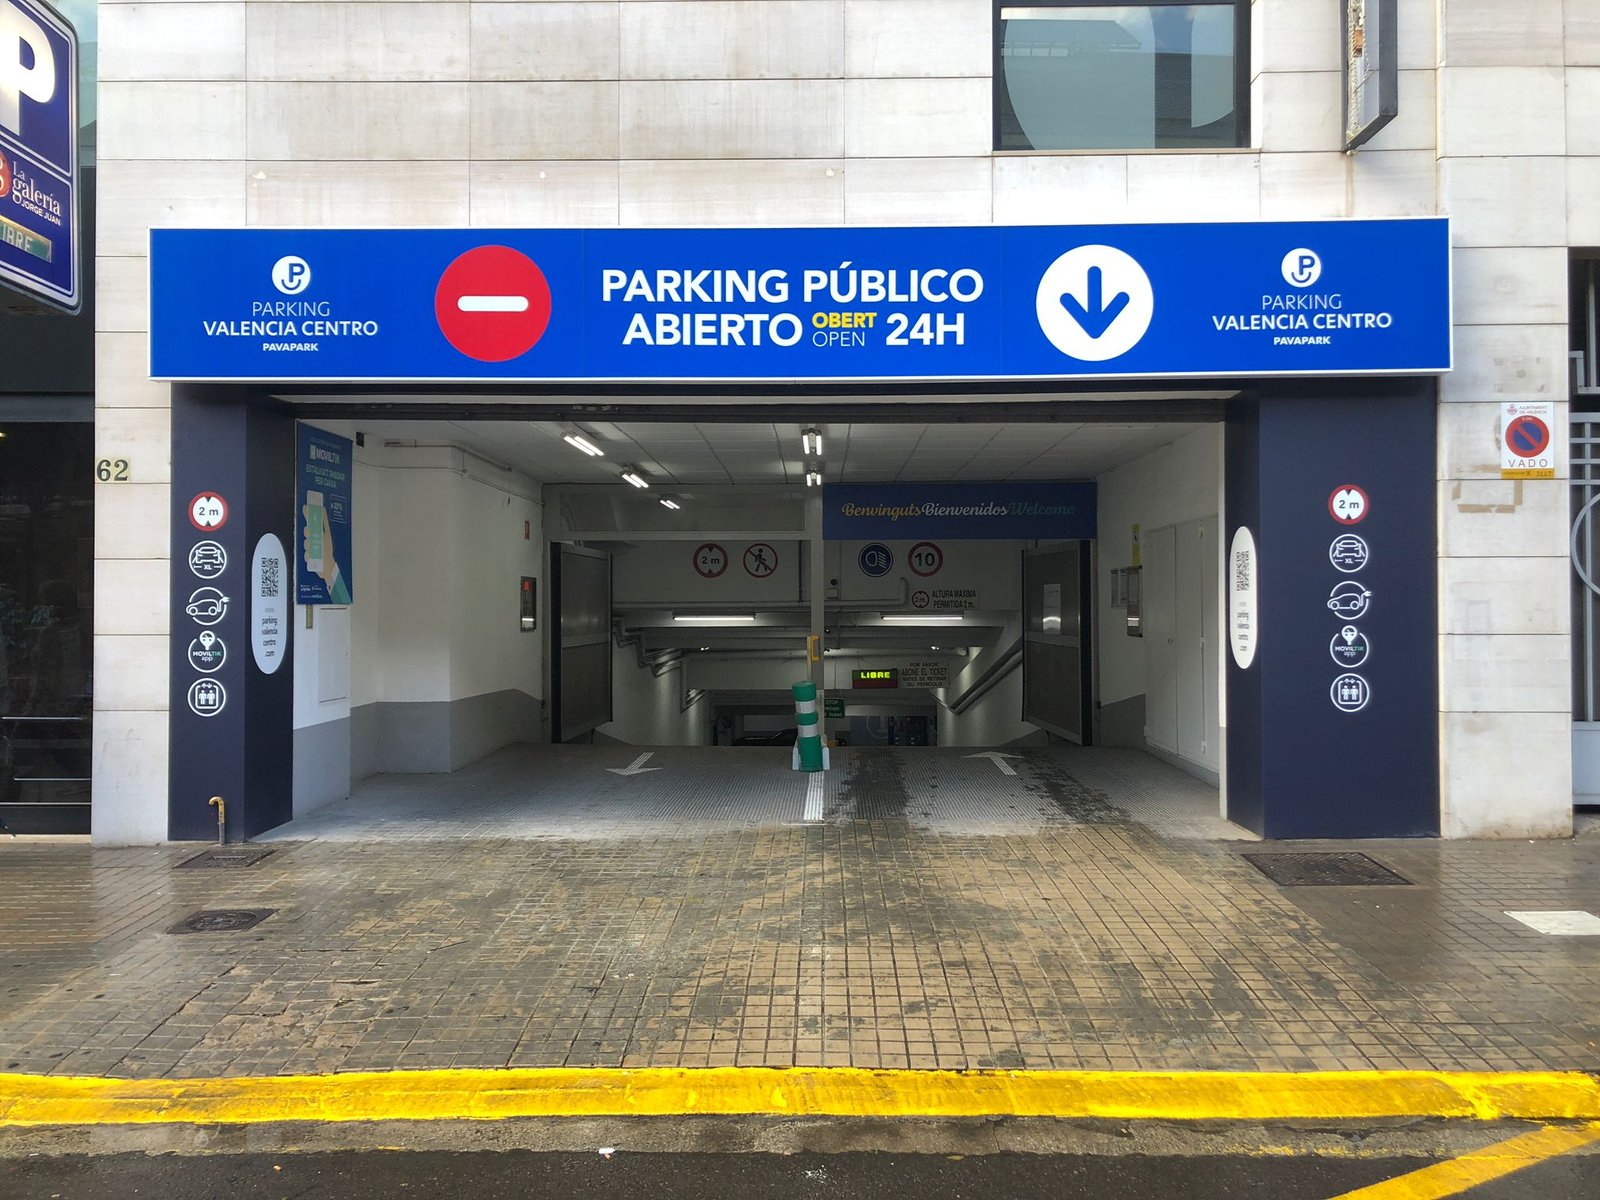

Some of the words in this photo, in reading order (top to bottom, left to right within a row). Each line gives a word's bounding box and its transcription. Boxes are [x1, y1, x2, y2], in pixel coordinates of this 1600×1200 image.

[13, 161, 25, 181] La
[12, 178, 61, 217] galería
[21, 199, 43, 217] JORGE
[43, 212, 61, 227] JUAN
[2, 223, 33, 252] IBRE
[602, 268, 789, 303] PARKING
[804, 261, 984, 303] PÚBLICO
[252, 301, 330, 317] PARKING
[1262, 293, 1342, 311] PARKING
[203, 320, 297, 337] VALENCIA
[301, 320, 378, 337] CENTRO
[622, 312, 803, 347] ABIERTO
[811, 311, 878, 329] OBERT
[885, 312, 965, 346] 24H
[1212, 313, 1309, 331] VALENCIA
[1312, 312, 1393, 330] CENTRO
[812, 330, 867, 347] OPEN
[1273, 335, 1331, 346] PAVAPARK
[262, 342, 319, 352] PAVAPARK
[96, 459, 129, 482] 62
[1508, 459, 1548, 468] VADO
[198, 506, 206, 516] 2
[209, 508, 219, 516] m
[841, 502, 921, 521] Benvinguts
[920, 501, 1009, 517] Bienvenidos
[1008, 502, 1077, 517] Welcome
[1338, 500, 1346, 509] 2
[701, 555, 708, 565] 2
[915, 552, 935, 567] 10
[931, 589, 954, 599] ALTURA
[933, 600, 963, 609] PERMITIDA
[860, 671, 891, 679] LIBRE
[902, 667, 919, 676] ABONE
[920, 668, 928, 676] EL
[929, 667, 947, 676] TICKET
